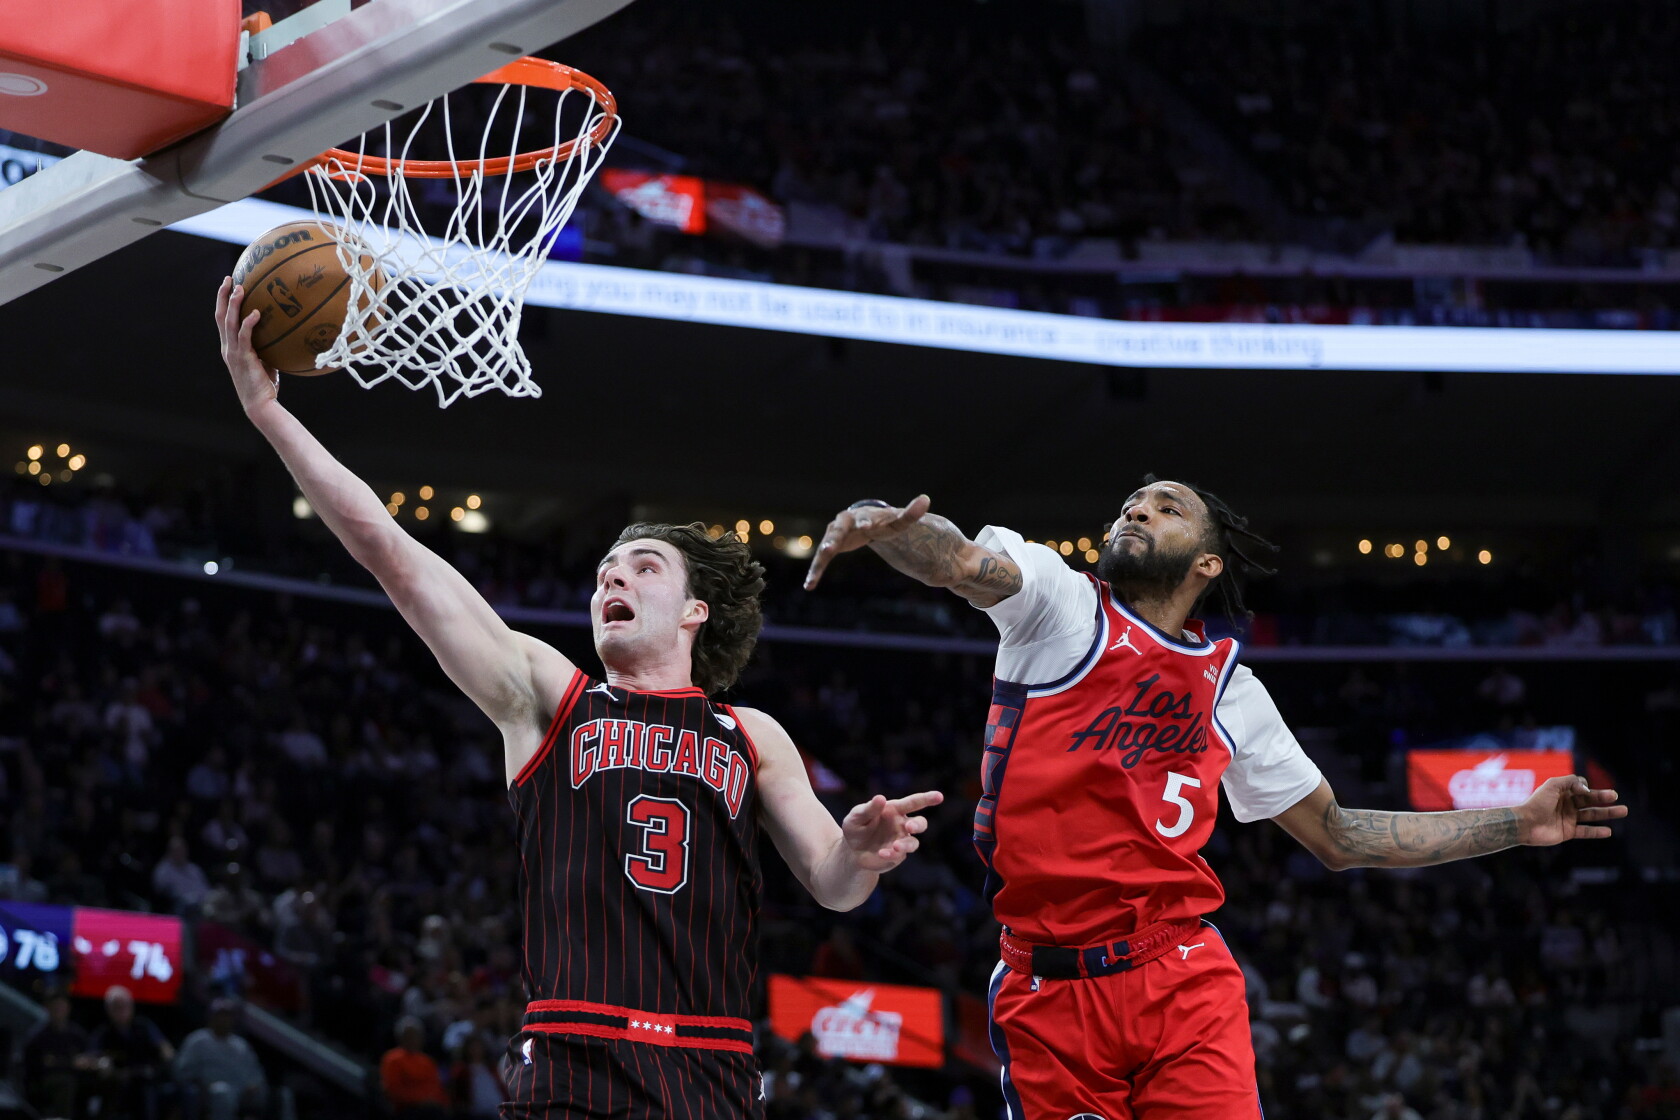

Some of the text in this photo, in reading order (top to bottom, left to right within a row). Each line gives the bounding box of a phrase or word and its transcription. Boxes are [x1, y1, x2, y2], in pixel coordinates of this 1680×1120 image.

[1125, 673, 1195, 719] Los
[571, 718, 748, 820] CHICAGO
[1155, 771, 1201, 838] 5
[625, 794, 690, 894] 3
